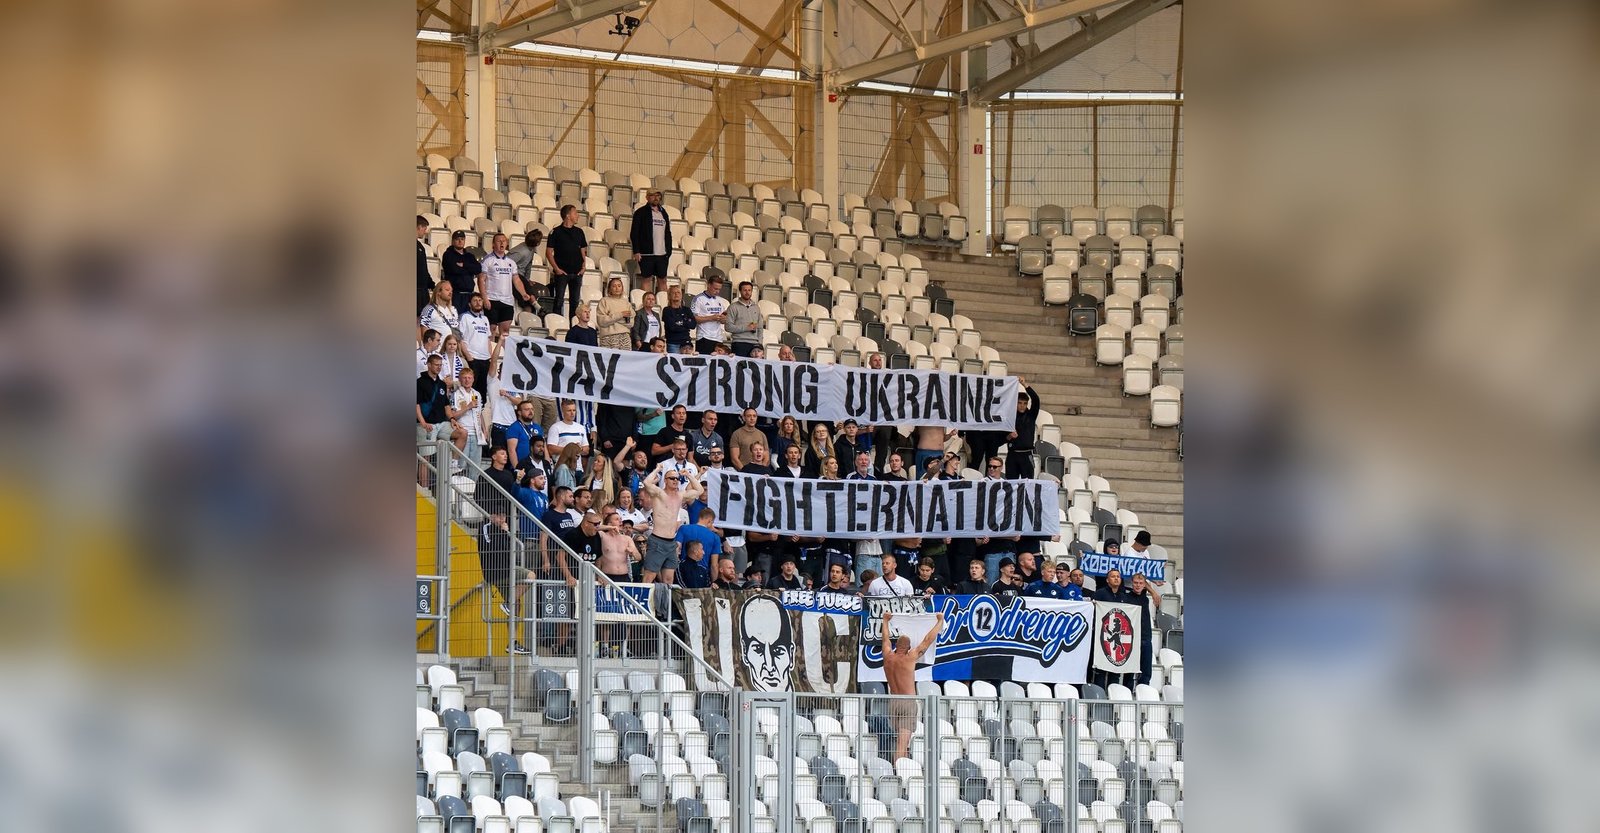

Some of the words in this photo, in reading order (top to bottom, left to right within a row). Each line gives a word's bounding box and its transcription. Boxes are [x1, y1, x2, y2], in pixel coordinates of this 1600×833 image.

[512, 339, 621, 400] STAY
[656, 356, 819, 414] STRONG
[845, 371, 1004, 423] UKRAINE
[719, 473, 1042, 533] FIGHTERNATION
[1080, 553, 1165, 578] KØBENHAVN
[783, 590, 814, 608] FREE
[975, 607, 992, 631] 12
